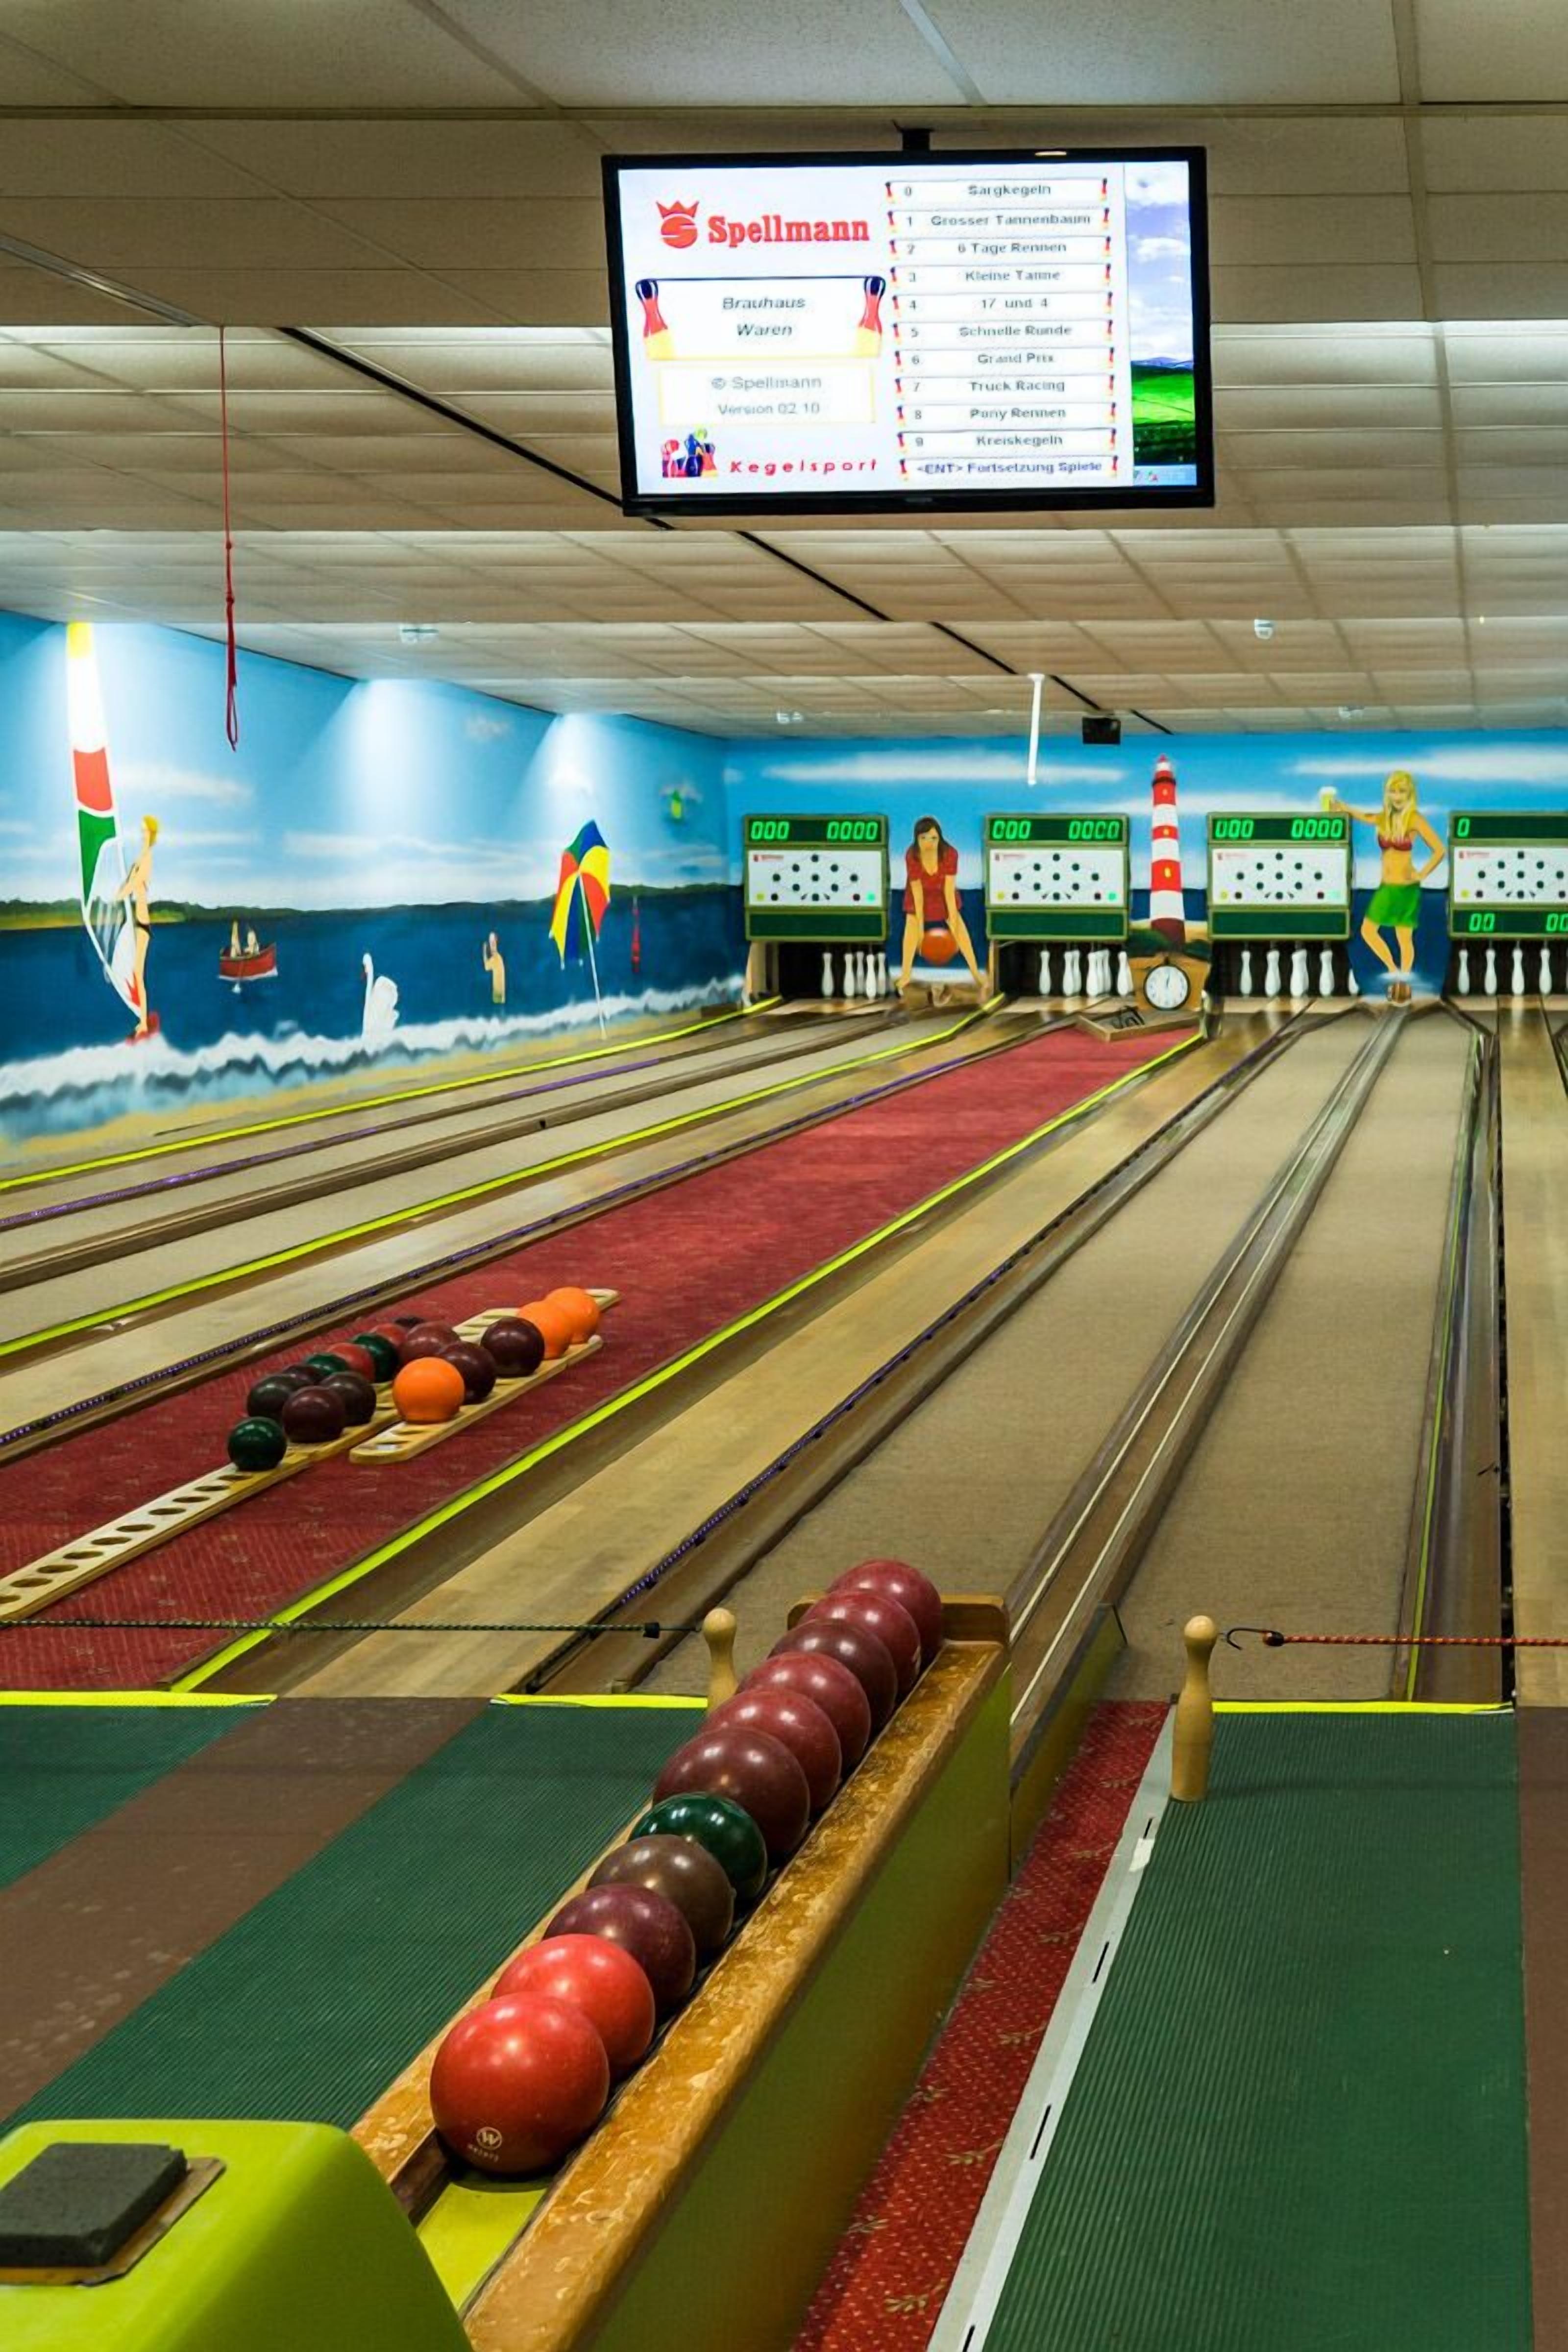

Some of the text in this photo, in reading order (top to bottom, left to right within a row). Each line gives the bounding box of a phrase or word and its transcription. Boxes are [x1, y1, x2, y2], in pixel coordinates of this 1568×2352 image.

[968, 184, 1051, 198] Sargkegeln
[907, 214, 1091, 226] 1 Grosser Tannenbaum
[708, 215, 870, 247] Spellmann
[971, 243, 1006, 255] Tage
[1010, 243, 1066, 252] Rennen
[966, 270, 1010, 281] Kleine
[1016, 270, 1060, 280] Tanne
[723, 297, 806, 310] Brauhaus
[910, 298, 1048, 310] 4 17 und 4
[737, 323, 792, 337] Waren
[911, 325, 1072, 338] 5 Schnelle Runde
[912, 353, 1054, 365] 6 Grand Prix
[732, 376, 821, 392] Spellmann
[914, 381, 1065, 392] 7 Truck Racing
[718, 404, 773, 416] Version
[914, 408, 1066, 420] 8 Pony Rennen
[976, 435, 1063, 447] Kreiskegeln
[730, 459, 876, 476] Kegelsport
[968, 463, 1054, 474] Fortsetzung
[1058, 462, 1102, 473] Spiele
[751, 821, 878, 840] 000 0000
[1215, 819, 1343, 838] 000 0000
[1470, 913, 1495, 931] 00
